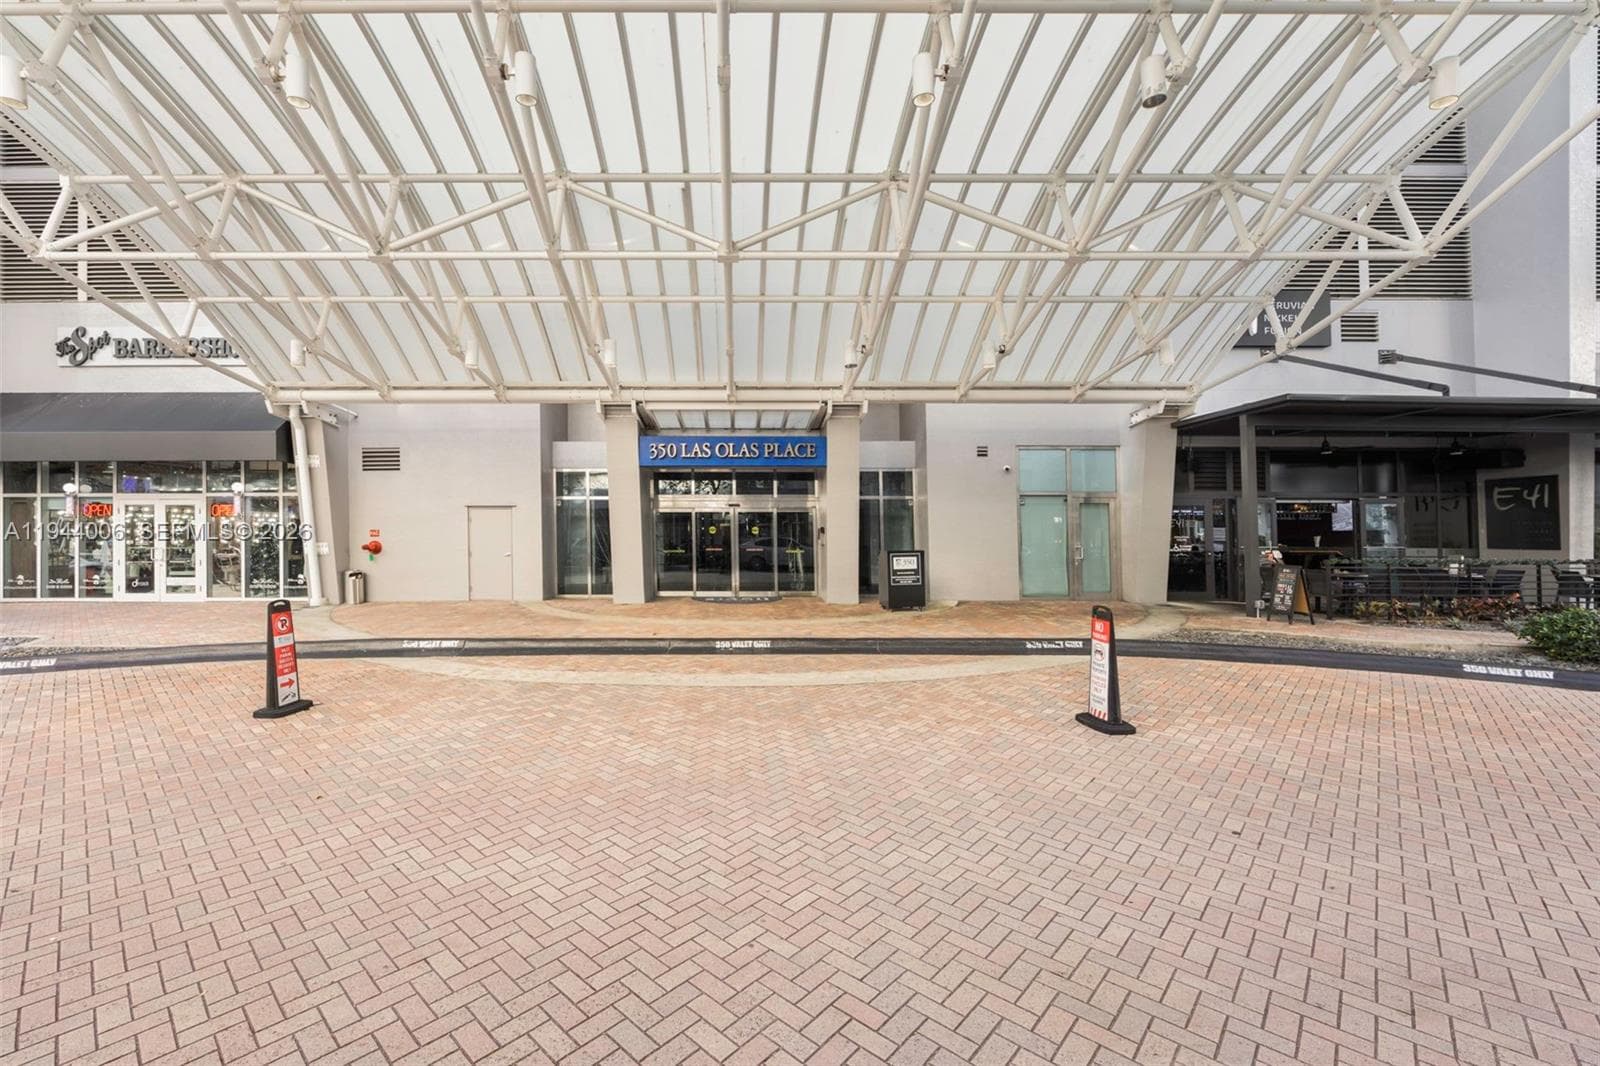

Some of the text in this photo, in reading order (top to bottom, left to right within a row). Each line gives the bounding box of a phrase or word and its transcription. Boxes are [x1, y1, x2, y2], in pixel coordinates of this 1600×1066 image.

[112, 337, 239, 359] BARBRSH
[649, 443, 817, 459] 350 LAS OLAS PLACE
[83, 503, 112, 517] OPEN
[211, 503, 236, 517] OPE
[1462, 664, 1487, 674] 350
[1487, 666, 1523, 677] VALET
